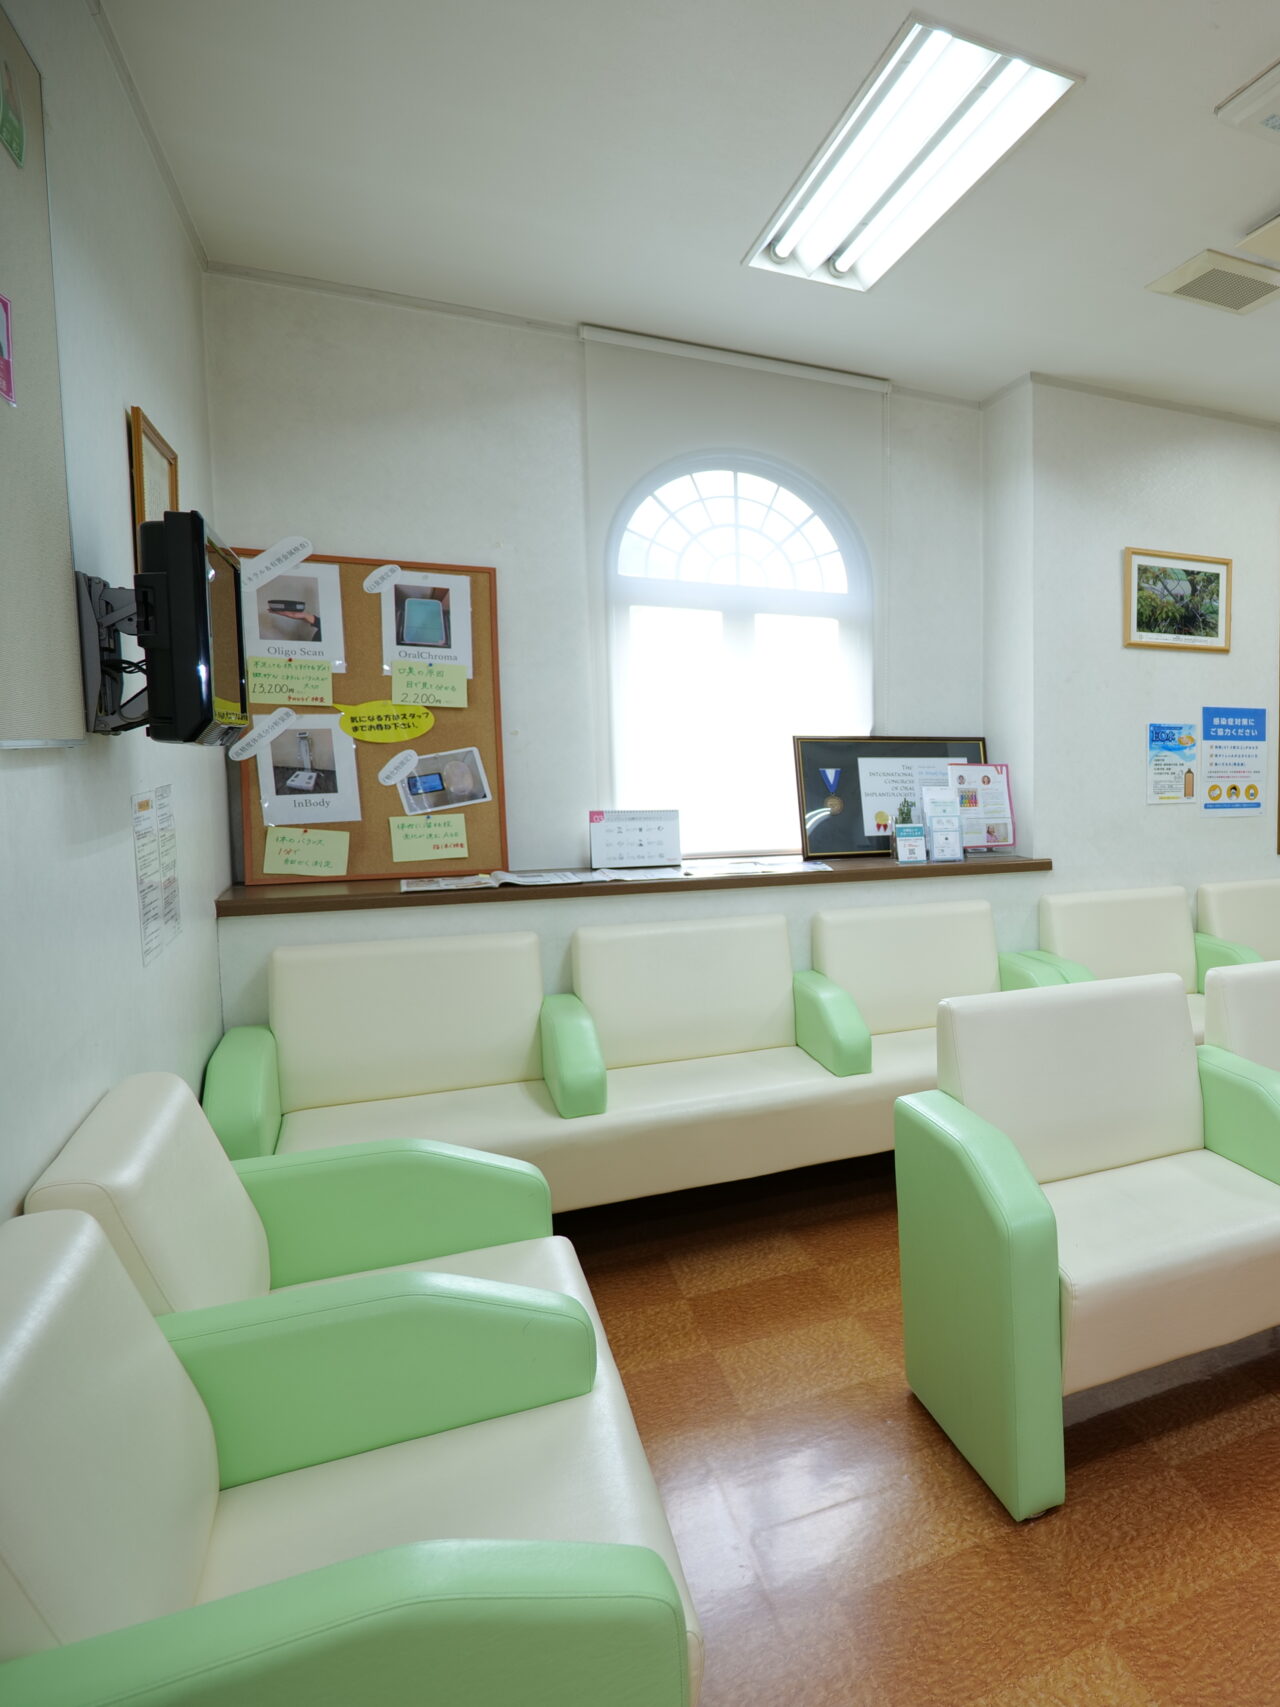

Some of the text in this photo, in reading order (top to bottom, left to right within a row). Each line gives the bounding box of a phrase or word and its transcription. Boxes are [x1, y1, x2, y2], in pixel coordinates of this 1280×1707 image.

[267, 646, 324, 657] Oligo Scan
[398, 650, 458, 661] OralChroma
[350, 712, 430, 723] 気になる方はスタッフ
[1213, 717, 1255, 726] 感染症対策に
[1210, 728, 1258, 736] ご協力ください
[293, 799, 331, 808] InBody
